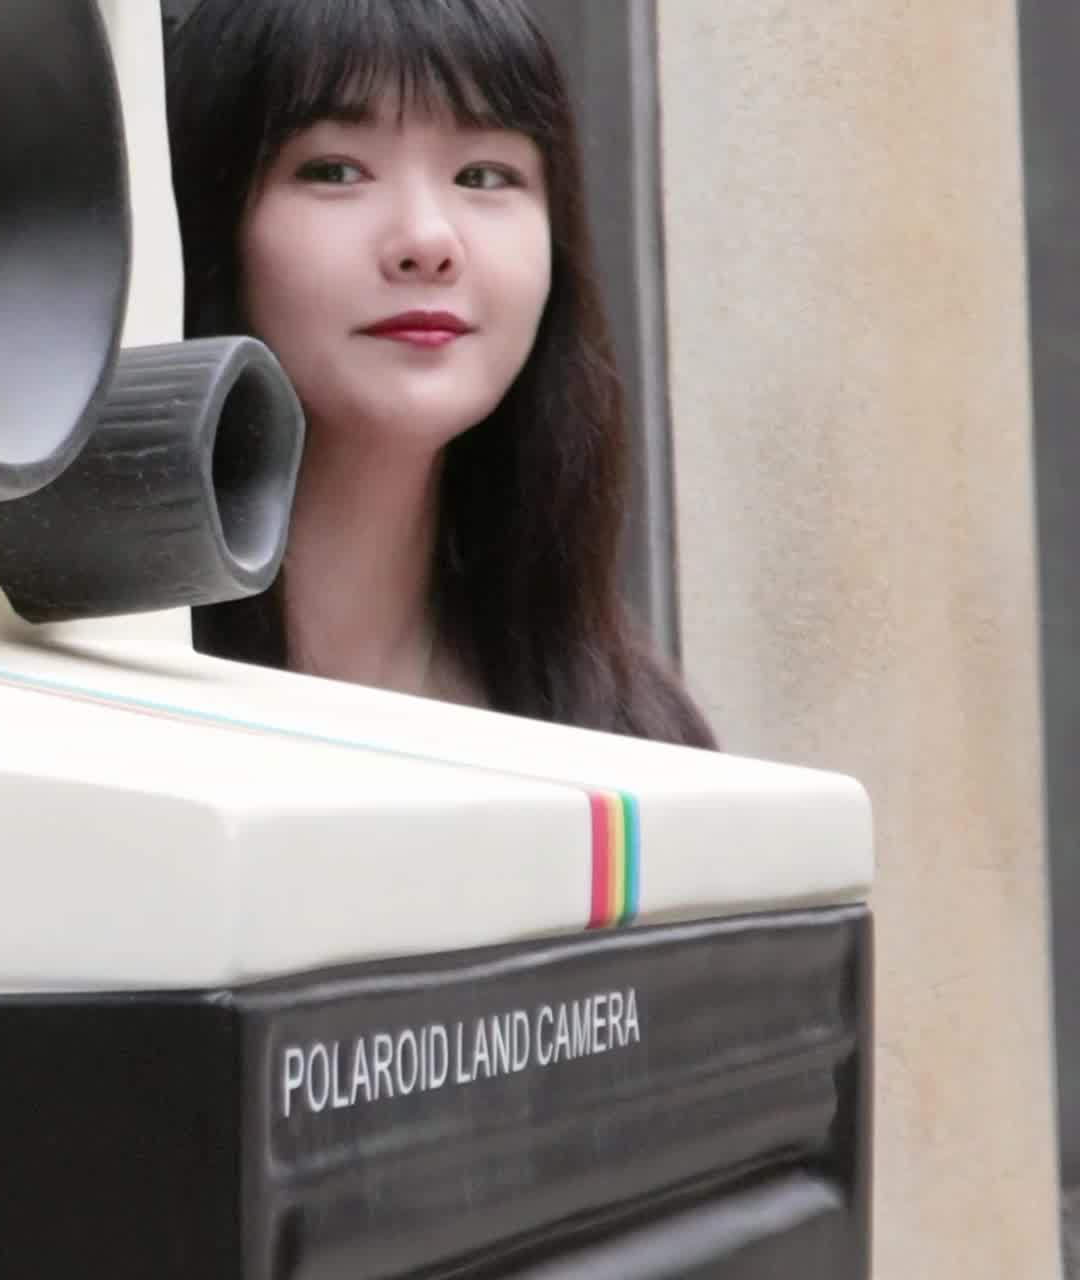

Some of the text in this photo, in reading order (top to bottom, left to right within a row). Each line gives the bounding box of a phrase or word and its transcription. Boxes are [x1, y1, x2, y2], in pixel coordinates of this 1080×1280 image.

[281, 987, 642, 1118] POLAROID LAND CAMERA
